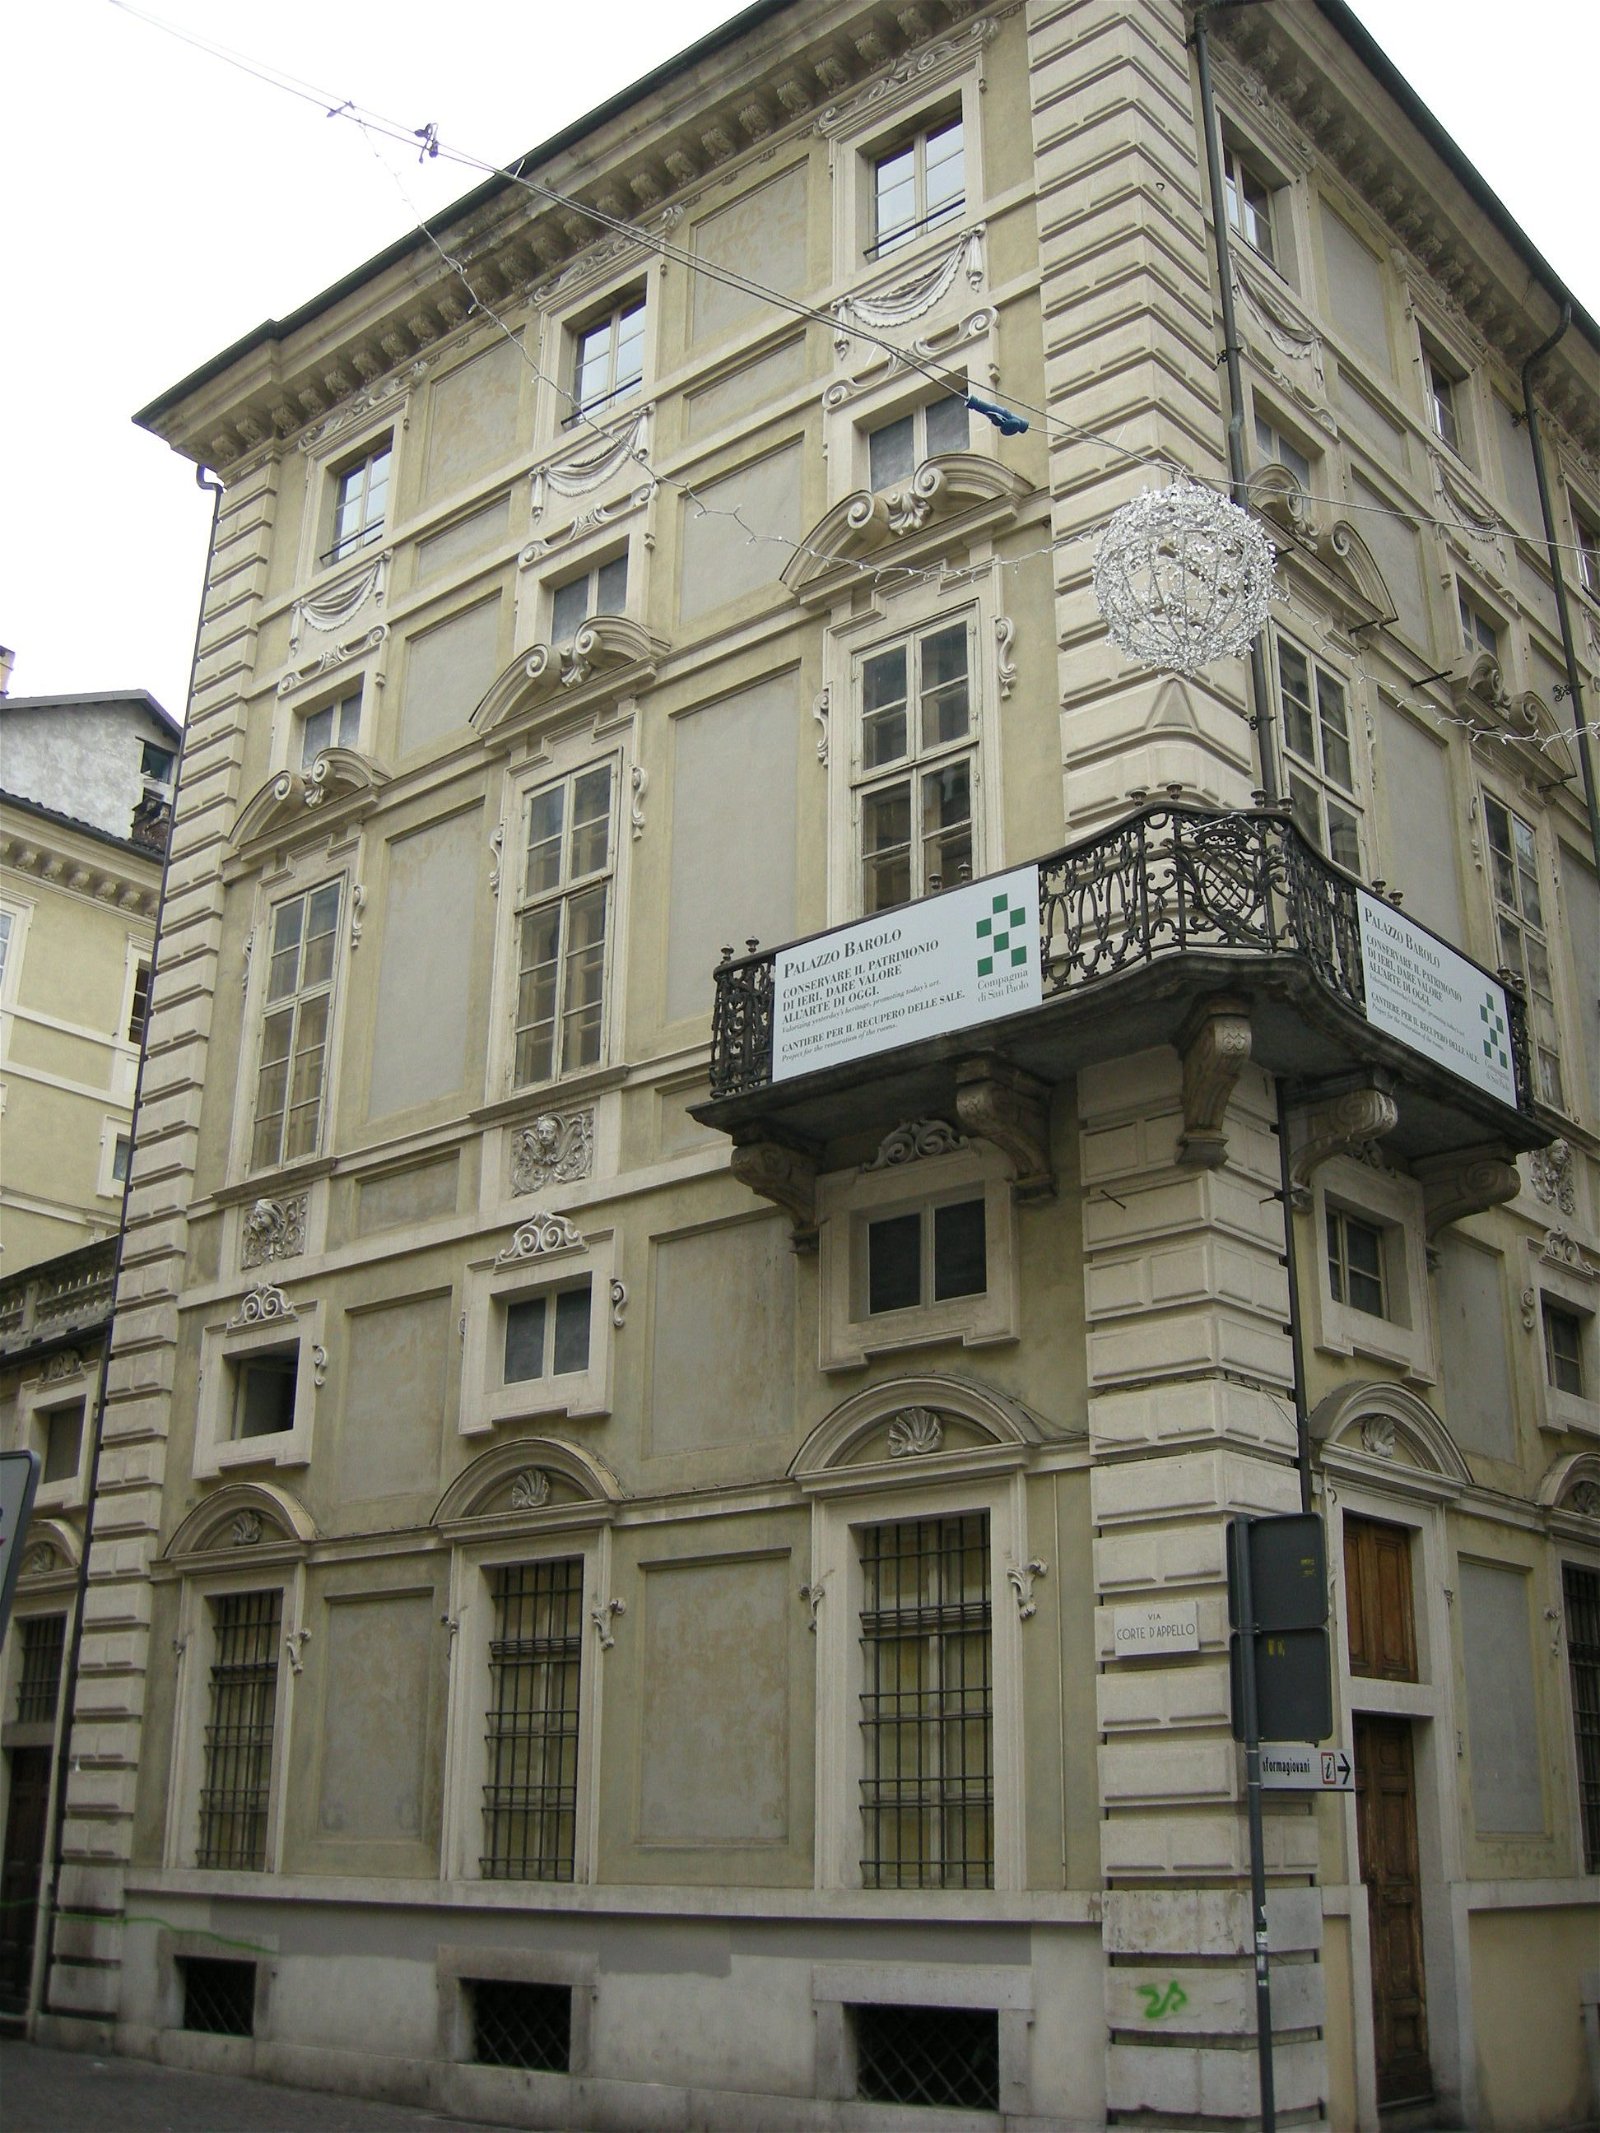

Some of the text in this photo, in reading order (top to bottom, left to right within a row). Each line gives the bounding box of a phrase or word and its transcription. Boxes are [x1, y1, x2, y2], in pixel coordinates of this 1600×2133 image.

[784, 929, 901, 978] PALAZZO BAROLO
[783, 940, 939, 999] CONSERVARE IL PATRIMONIO
[1366, 934, 1462, 1003] CONSERVARE IL PATRIMONIO
[1397, 965, 1416, 985] DARE
[783, 1000, 794, 1012] DI
[826, 979, 855, 997] DARE
[859, 964, 901, 986] VALORE
[977, 969, 1028, 990] Compagnia
[988, 991, 1003, 999] San
[1006, 980, 1028, 994] Paolo
[784, 986, 879, 1023] ALL'ARTE DI OGGI.
[873, 991, 904, 1006] promoting
[782, 990, 965, 1052] CANTIERE PER IL RECUPERO DELLE SALE.
[782, 1051, 803, 1062] Project
[1147, 1612, 1161, 1621] VIA
[1117, 1623, 1196, 1641] CORTE D'APPELLO
